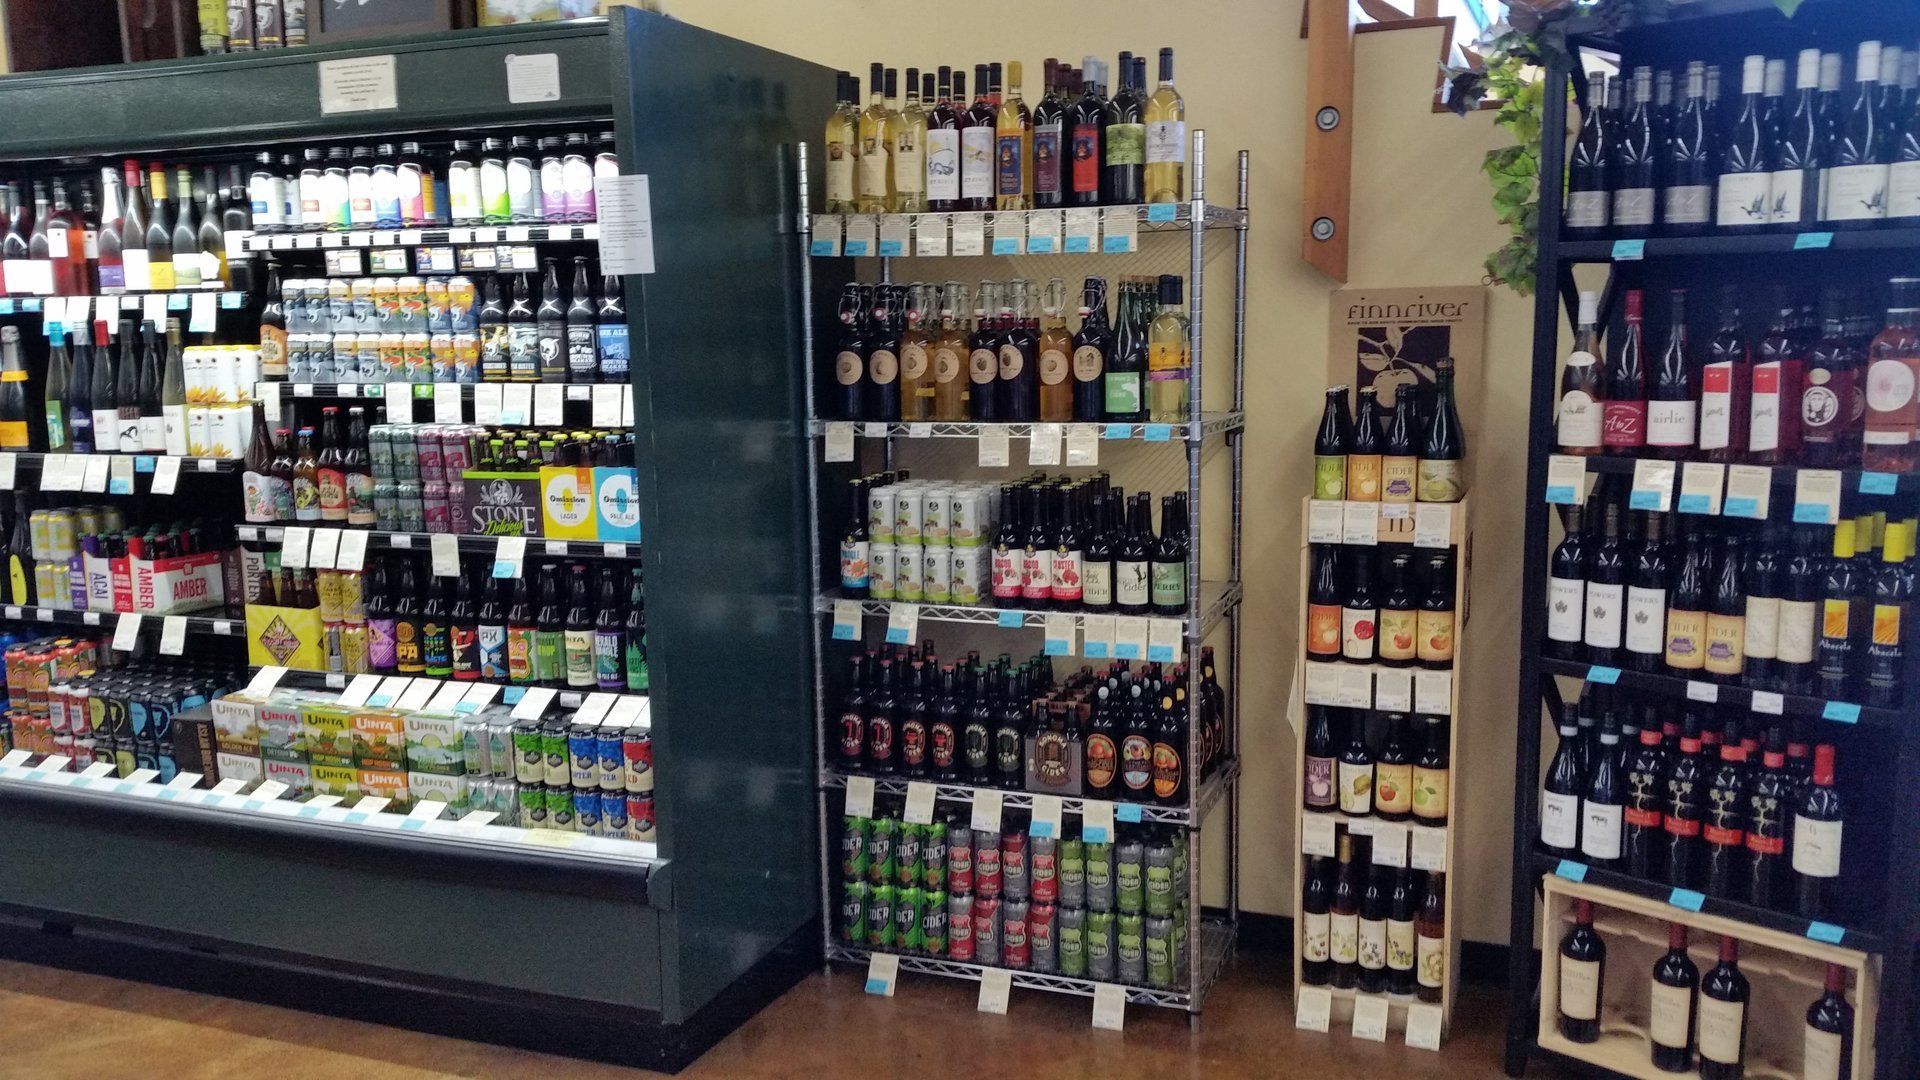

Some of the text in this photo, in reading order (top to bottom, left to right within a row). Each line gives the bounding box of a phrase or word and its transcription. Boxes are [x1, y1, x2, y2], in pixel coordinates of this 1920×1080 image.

[1348, 296, 1469, 319] finnriver
[1653, 410, 1685, 424] airlie
[550, 495, 585, 503] Omission
[472, 505, 537, 535] STONE
[138, 566, 154, 609] AMBER
[173, 578, 207, 601] AMBER
[1154, 583, 1180, 591] PERRY
[1819, 639, 1851, 652] Abacela
[216, 704, 250, 718] UINTA
[261, 710, 298, 724] UINTA
[307, 714, 345, 729] UINTA
[355, 717, 394, 732] UINTA
[409, 720, 448, 734] UINTA
[1038, 734, 1067, 749] SONOMA
[268, 762, 304, 777] UINTA
[315, 769, 353, 781] UINTA
[1041, 764, 1066, 776] CIDER
[363, 773, 402, 787] UINTA
[413, 775, 453, 790] UINTA
[922, 845, 946, 860] CIDER
[923, 912, 947, 929] CIDER
